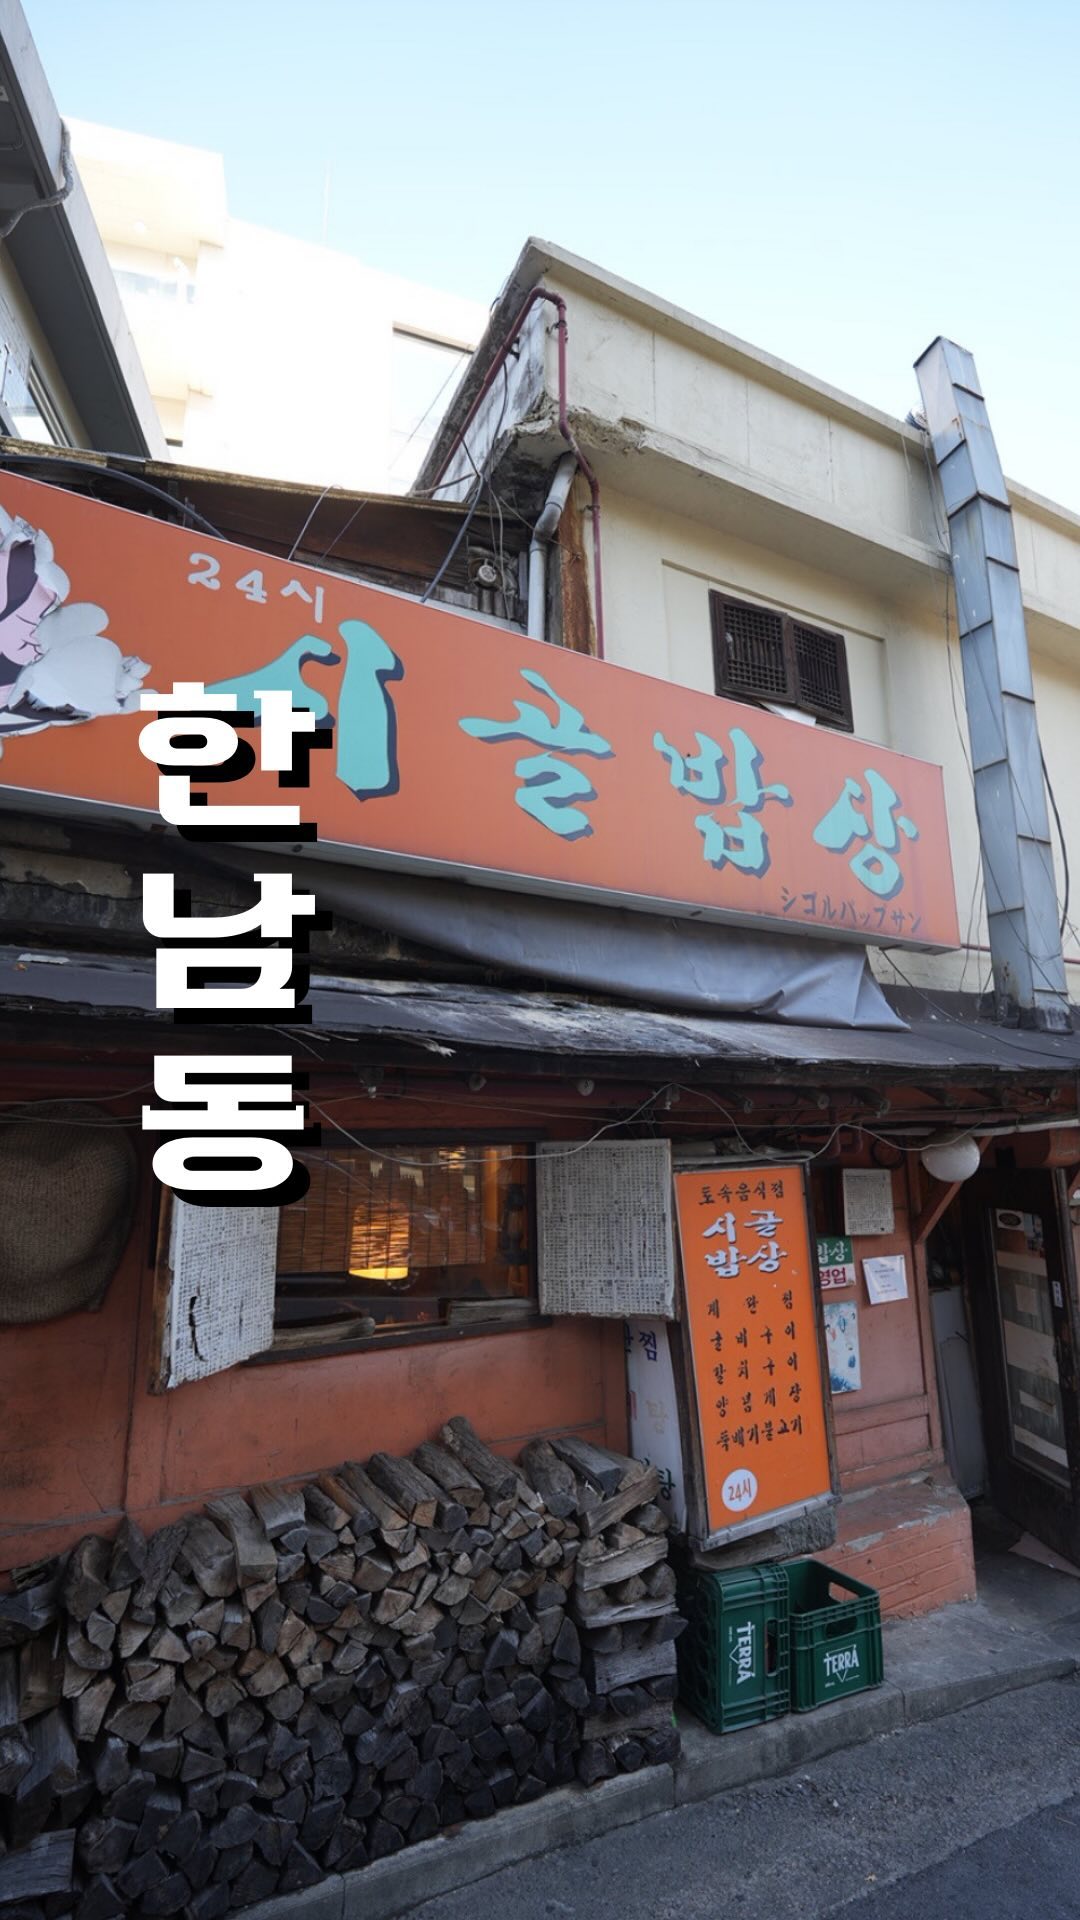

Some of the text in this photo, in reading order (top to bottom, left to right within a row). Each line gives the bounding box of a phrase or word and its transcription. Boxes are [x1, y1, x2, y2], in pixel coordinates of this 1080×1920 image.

[188, 552, 324, 624] 24시
[699, 1180, 784, 1205] 토속음식점
[703, 1210, 784, 1244] 시골
[704, 1241, 788, 1278] 밥상
[713, 1352, 798, 1385] 갈치구이
[716, 1414, 803, 1452] 뚝배기불고기
[728, 1478, 752, 1502] 24시
[737, 1621, 755, 1685] TERRA
[824, 1645, 860, 1677] TERRA
